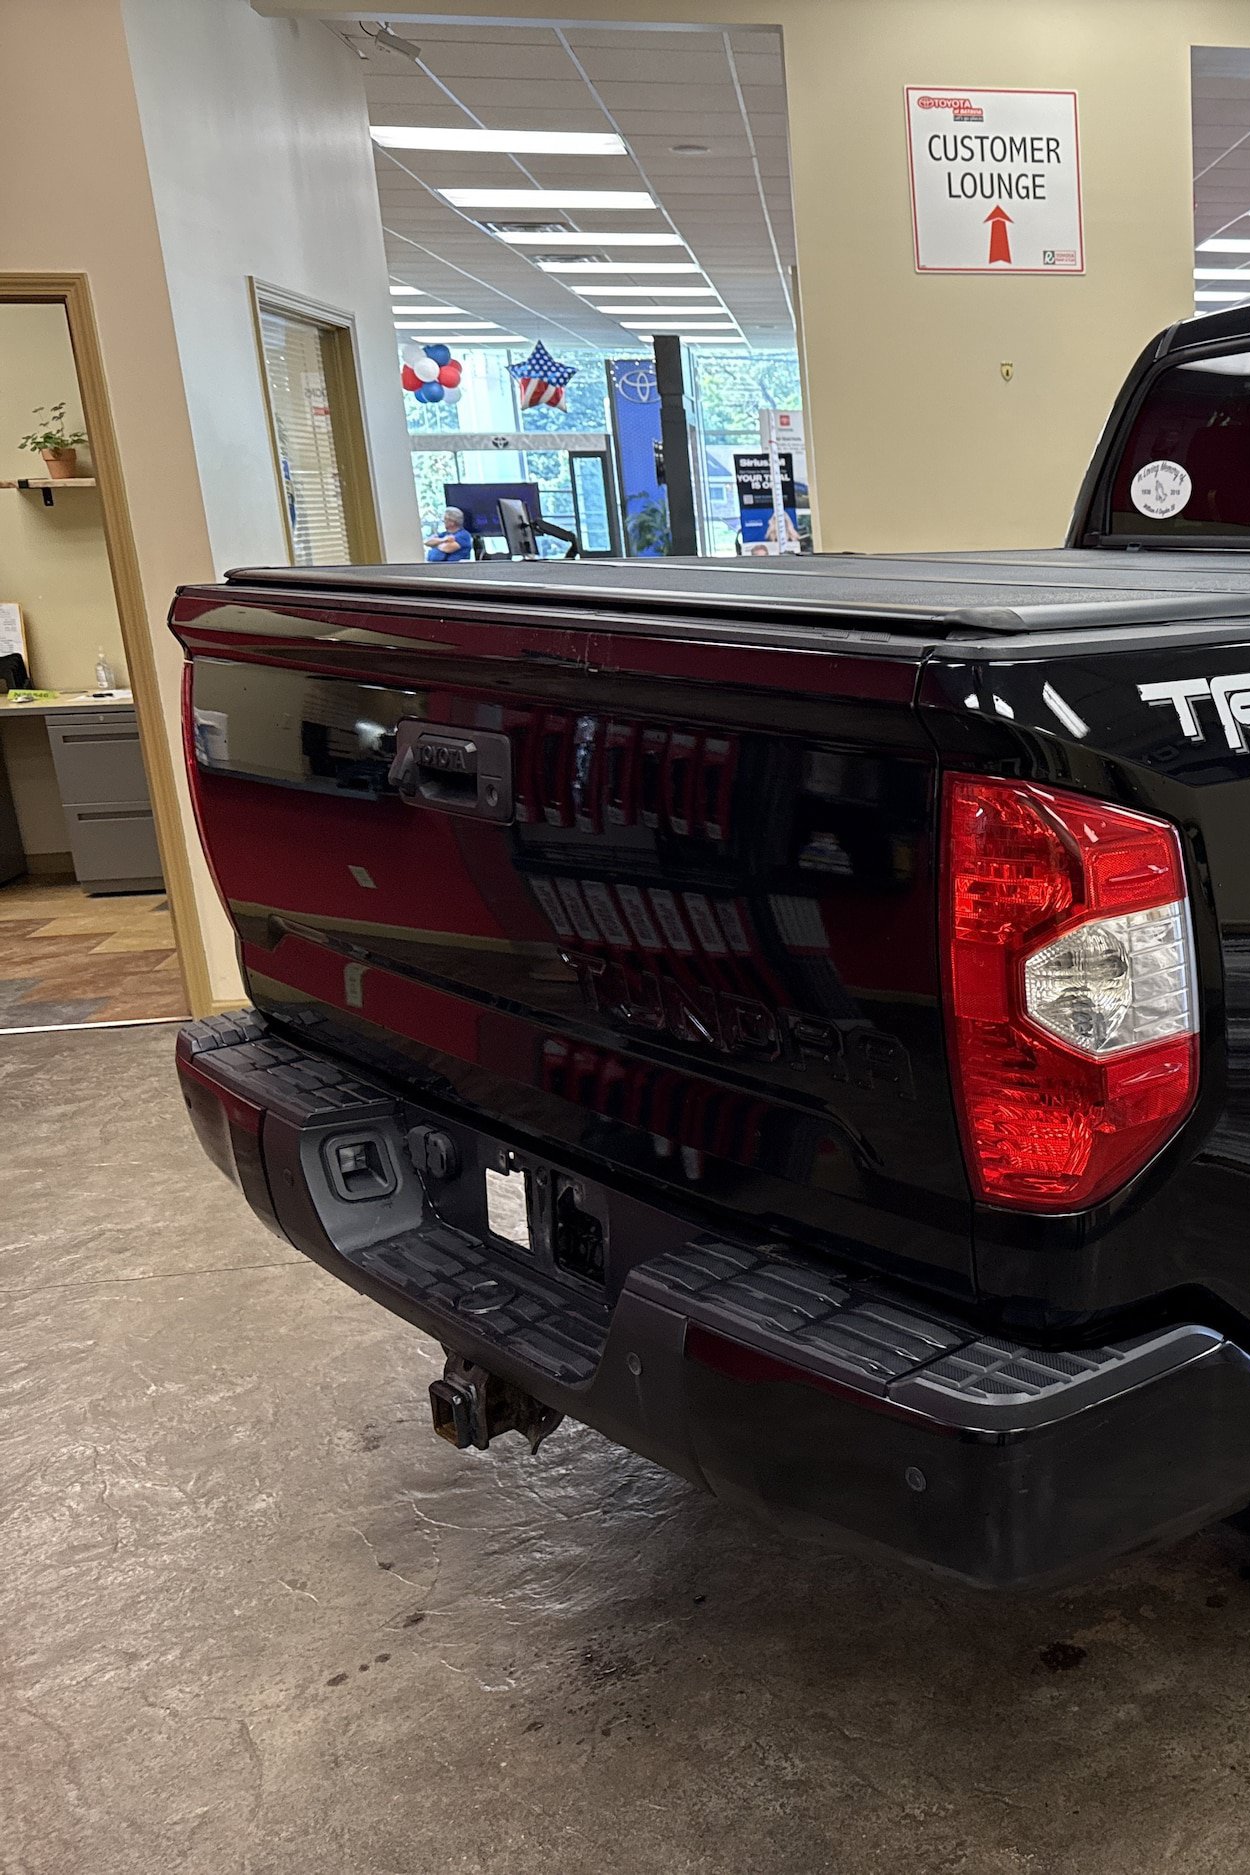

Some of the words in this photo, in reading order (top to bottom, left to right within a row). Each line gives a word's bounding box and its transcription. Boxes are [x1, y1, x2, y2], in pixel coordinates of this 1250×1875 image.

[933, 99, 971, 108] TOYOTA
[928, 134, 1061, 164] CUSTOMER
[947, 172, 1046, 200] LOUNGE
[737, 473, 762, 483] YOUR
